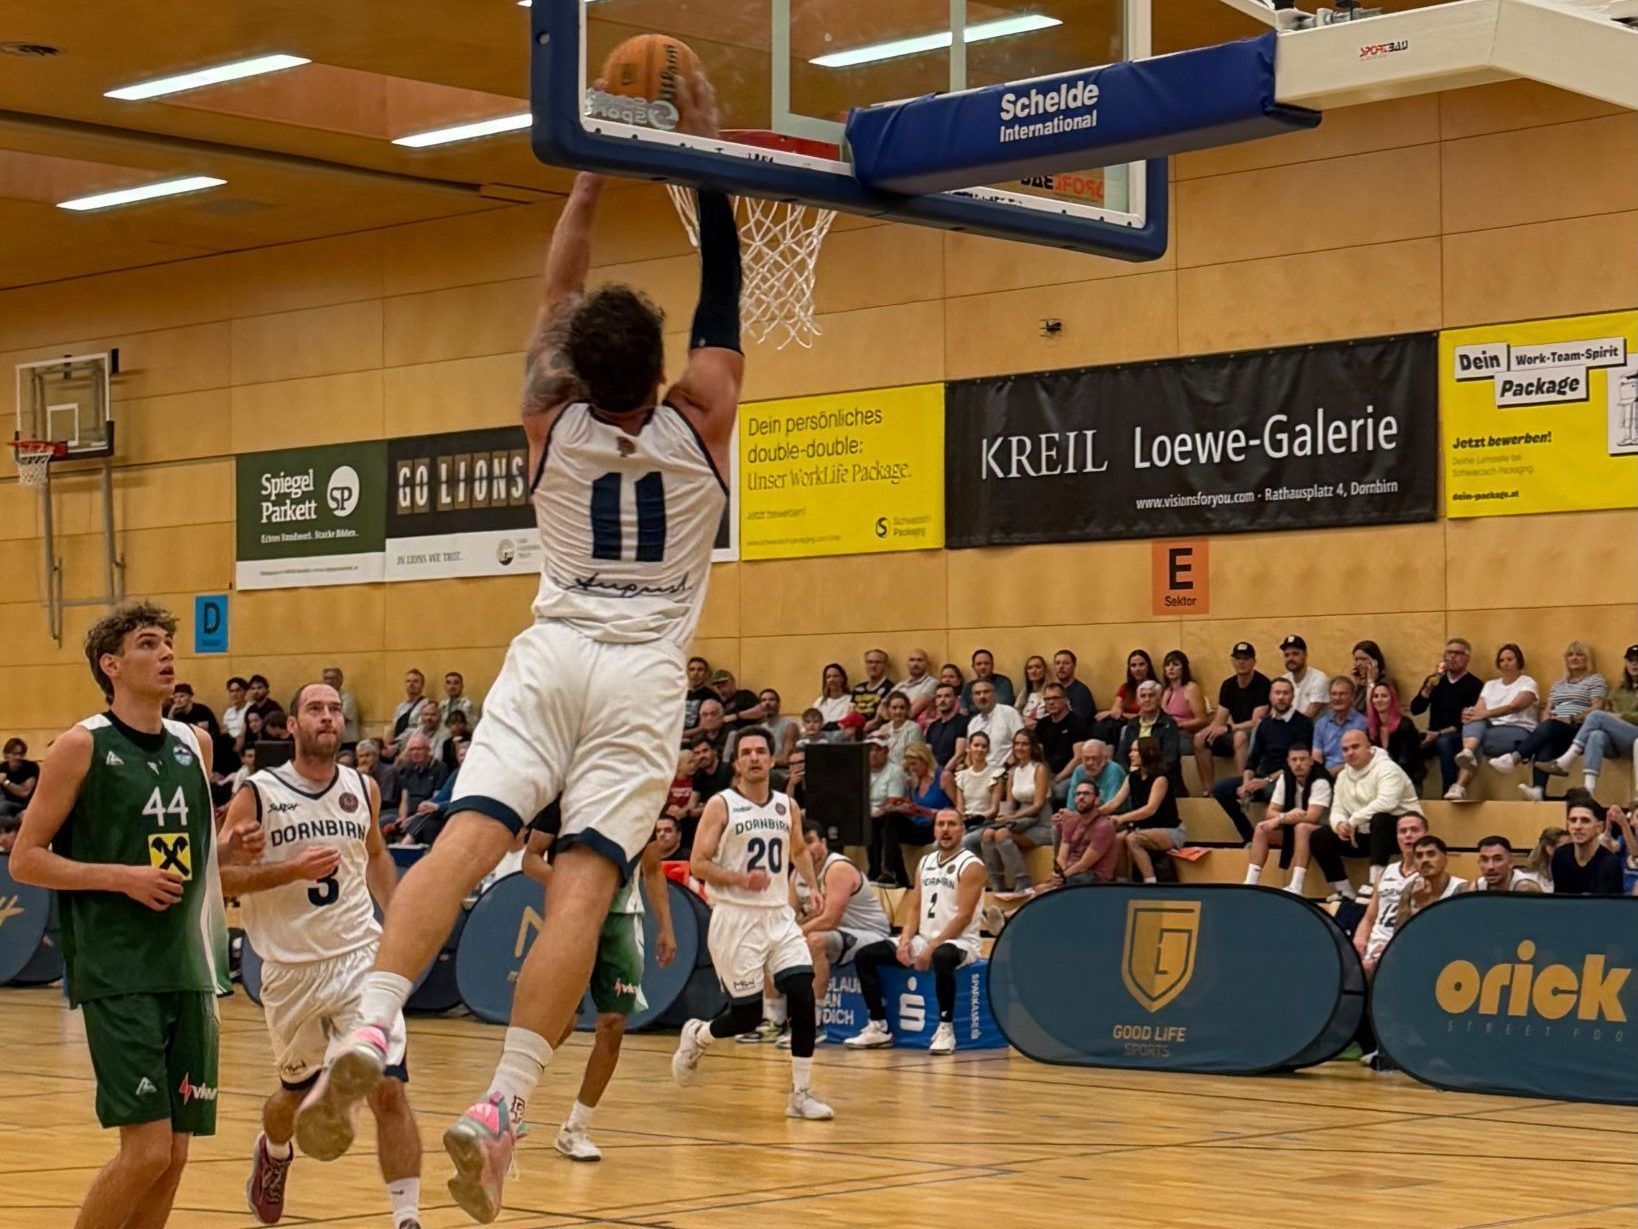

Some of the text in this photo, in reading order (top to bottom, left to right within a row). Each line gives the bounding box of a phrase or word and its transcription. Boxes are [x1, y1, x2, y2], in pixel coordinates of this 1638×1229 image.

[1000, 81, 1100, 121] Schelde
[1000, 110, 1098, 142] International
[1458, 351, 1501, 371] Dein
[1515, 345, 1619, 366] Work-Team-Spirit
[1500, 376, 1581, 398] Package
[748, 408, 883, 437] Dein persönliches
[1134, 405, 1399, 469] Loewe-Galerie
[748, 436, 864, 463] double-double:
[981, 430, 1108, 479] KREIL
[1452, 437, 1486, 449] Jetzt
[261, 468, 315, 500] Spiegel
[398, 455, 525, 508] GO LIONS
[748, 472, 787, 490] Unser
[790, 463, 849, 487] WorkLife
[330, 486, 353, 511] SP
[1136, 490, 1255, 509] www.visionsforyou.com
[1264, 483, 1334, 501] Rathausplatz
[1350, 479, 1399, 495] Dornbirn
[261, 499, 318, 523] Parkett
[590, 472, 667, 562] 11
[1169, 547, 1194, 591] E
[1164, 595, 1198, 607] Sektor
[204, 602, 220, 635] D
[142, 785, 189, 827] 44
[271, 819, 366, 847] DORNBIRN
[747, 837, 783, 873] 20
[308, 866, 339, 907] 3
[1435, 940, 1632, 1022] orick
[1113, 1024, 1187, 1042] GOOD LIFE
